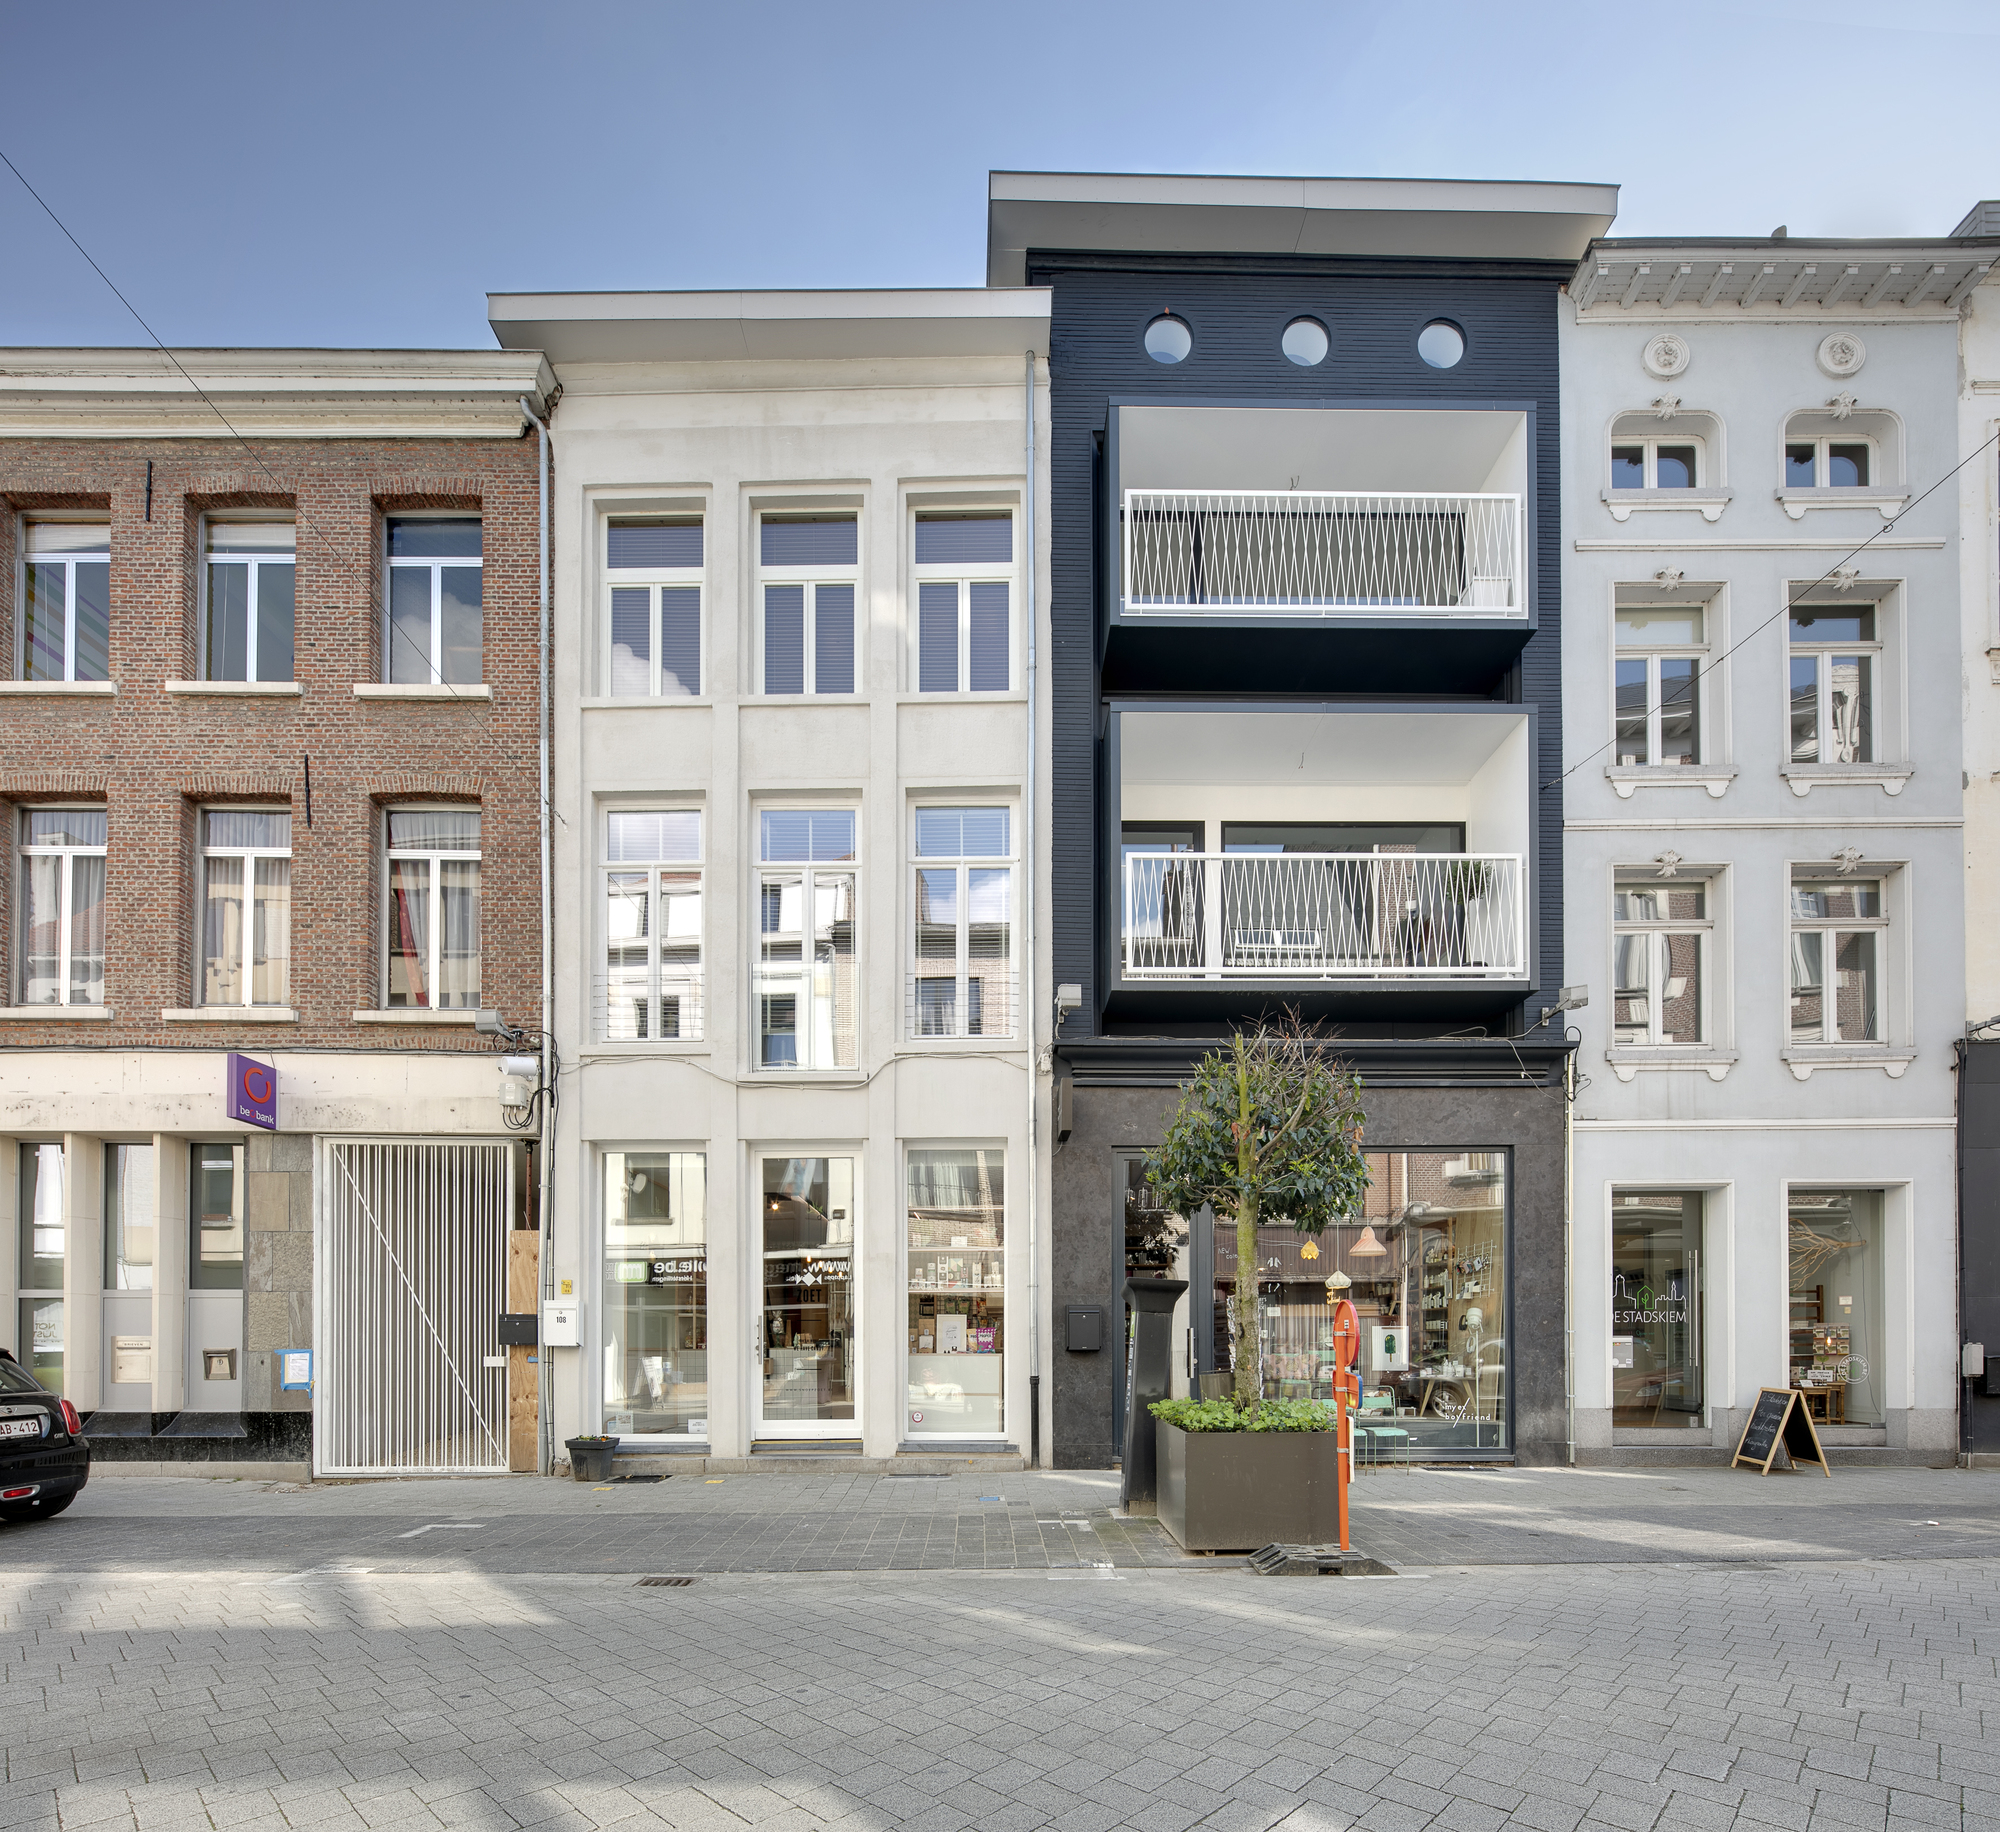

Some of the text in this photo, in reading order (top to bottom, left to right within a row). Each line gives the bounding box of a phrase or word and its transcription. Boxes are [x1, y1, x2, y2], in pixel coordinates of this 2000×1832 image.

[239, 1104, 275, 1124] beobank
[796, 1288, 822, 1303] ZOET
[556, 1316, 567, 1324] 108
[1612, 1310, 1687, 1323] E STADSKIEM
[1444, 1404, 1457, 1413] my
[1444, 1412, 1491, 1421] boyfriend
